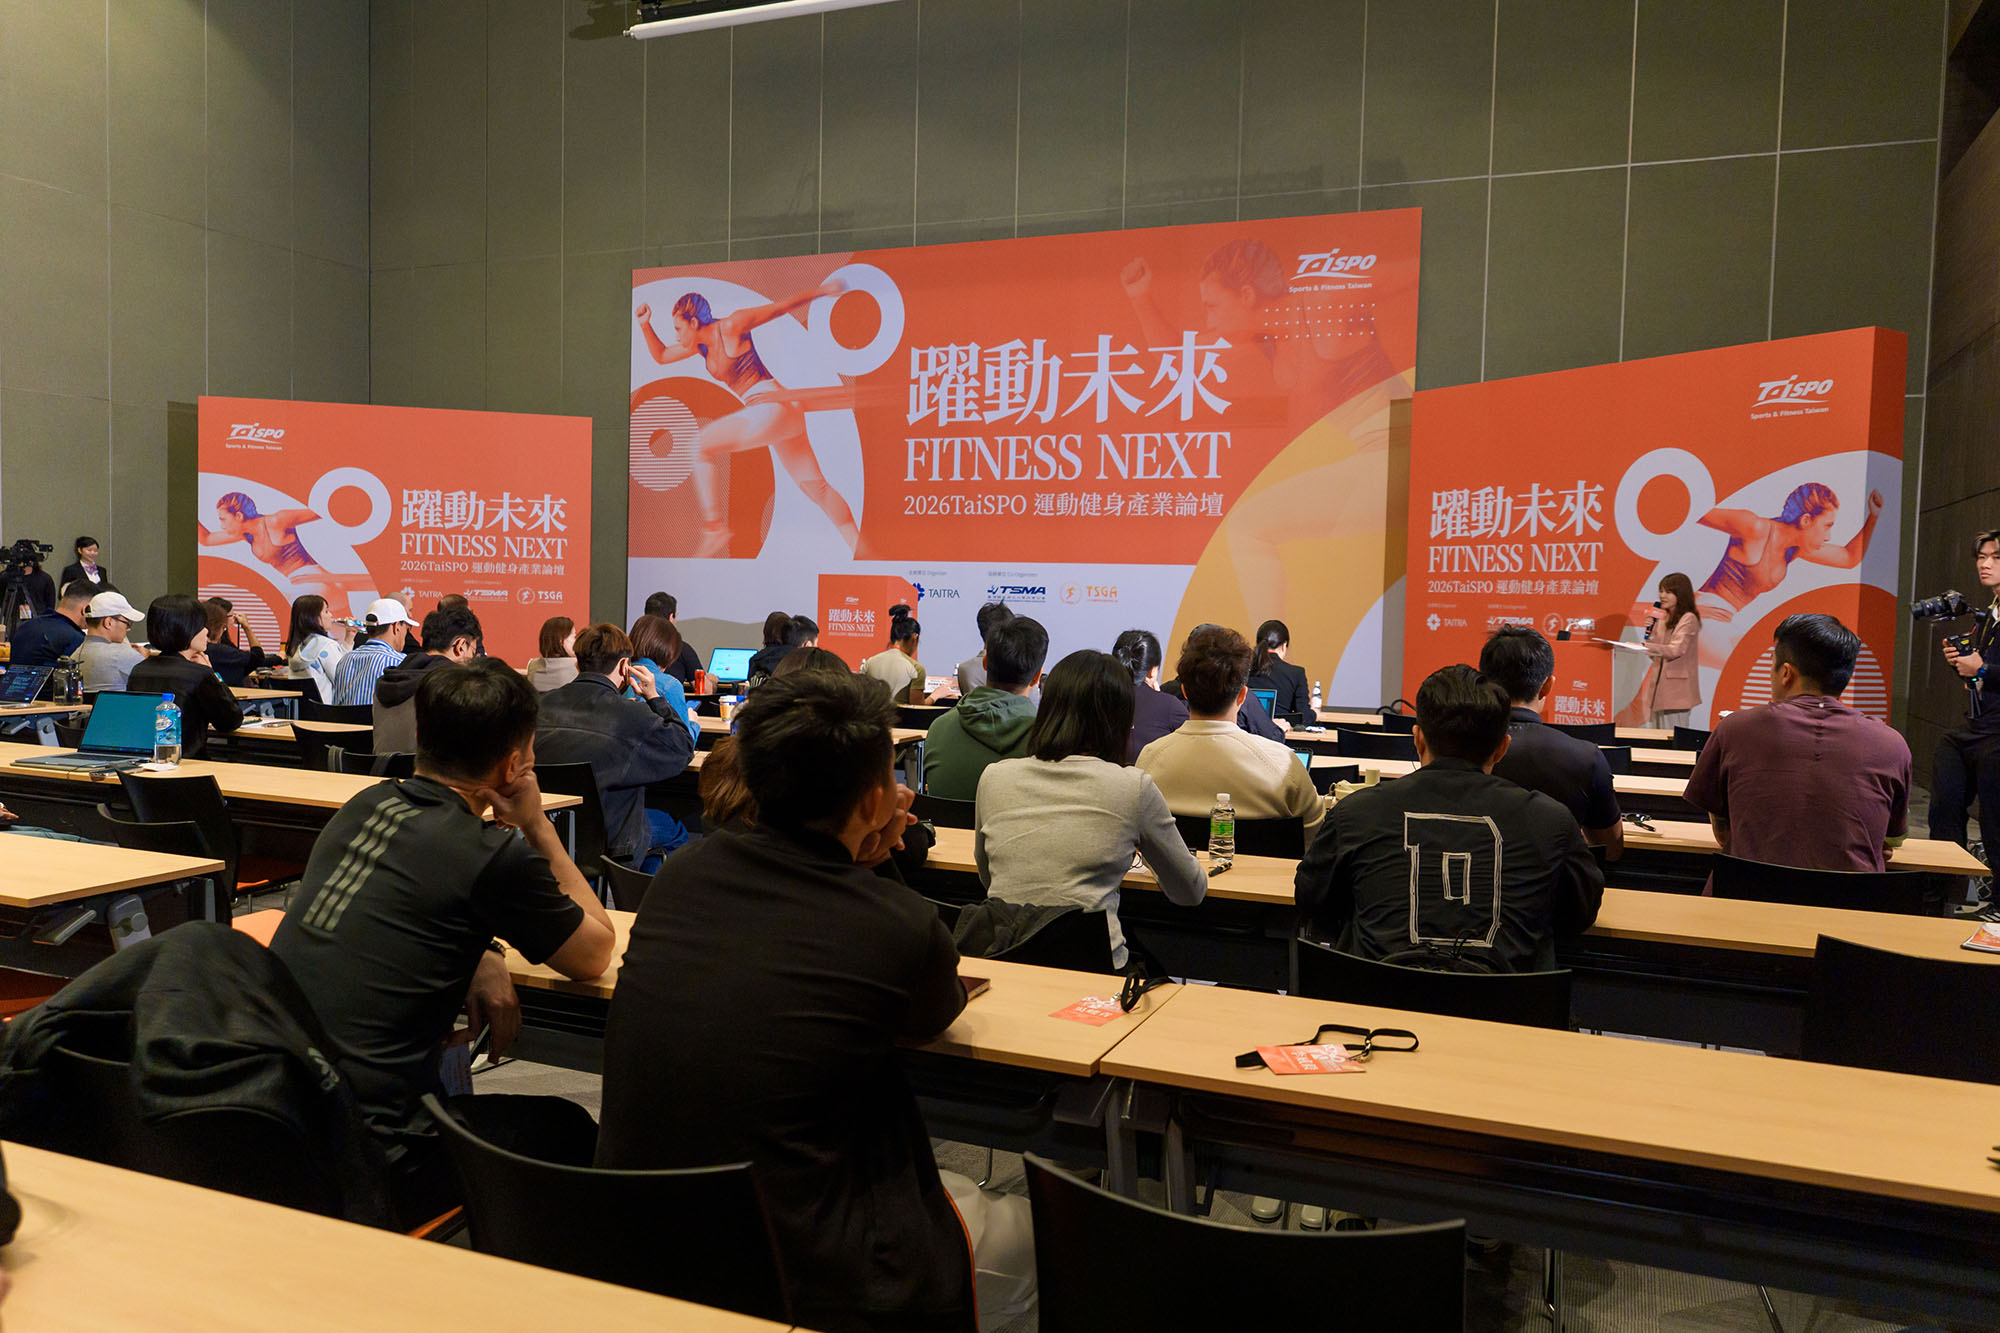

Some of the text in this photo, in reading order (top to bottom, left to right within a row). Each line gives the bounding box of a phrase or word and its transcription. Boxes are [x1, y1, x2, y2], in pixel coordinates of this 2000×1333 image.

[906, 330, 1232, 427] 躍動未來
[904, 431, 1232, 482] FITNESS NEXT
[401, 488, 568, 534] 躍動未來
[903, 491, 1225, 518] 2026TaiSPO 運動健身產業論壇
[1430, 480, 1605, 540] 躍動未來
[400, 532, 568, 560] FITNESS NEXT
[1428, 542, 1604, 573] FITNESS NEXT
[400, 560, 469, 573] 2026TaiSPO
[537, 590, 563, 601] TSGA
[929, 588, 961, 599] TAITRA
[1000, 585, 1047, 595] TSMA
[1086, 585, 1119, 598] TSGA
[1428, 580, 1494, 593] 2026TaiSPO
